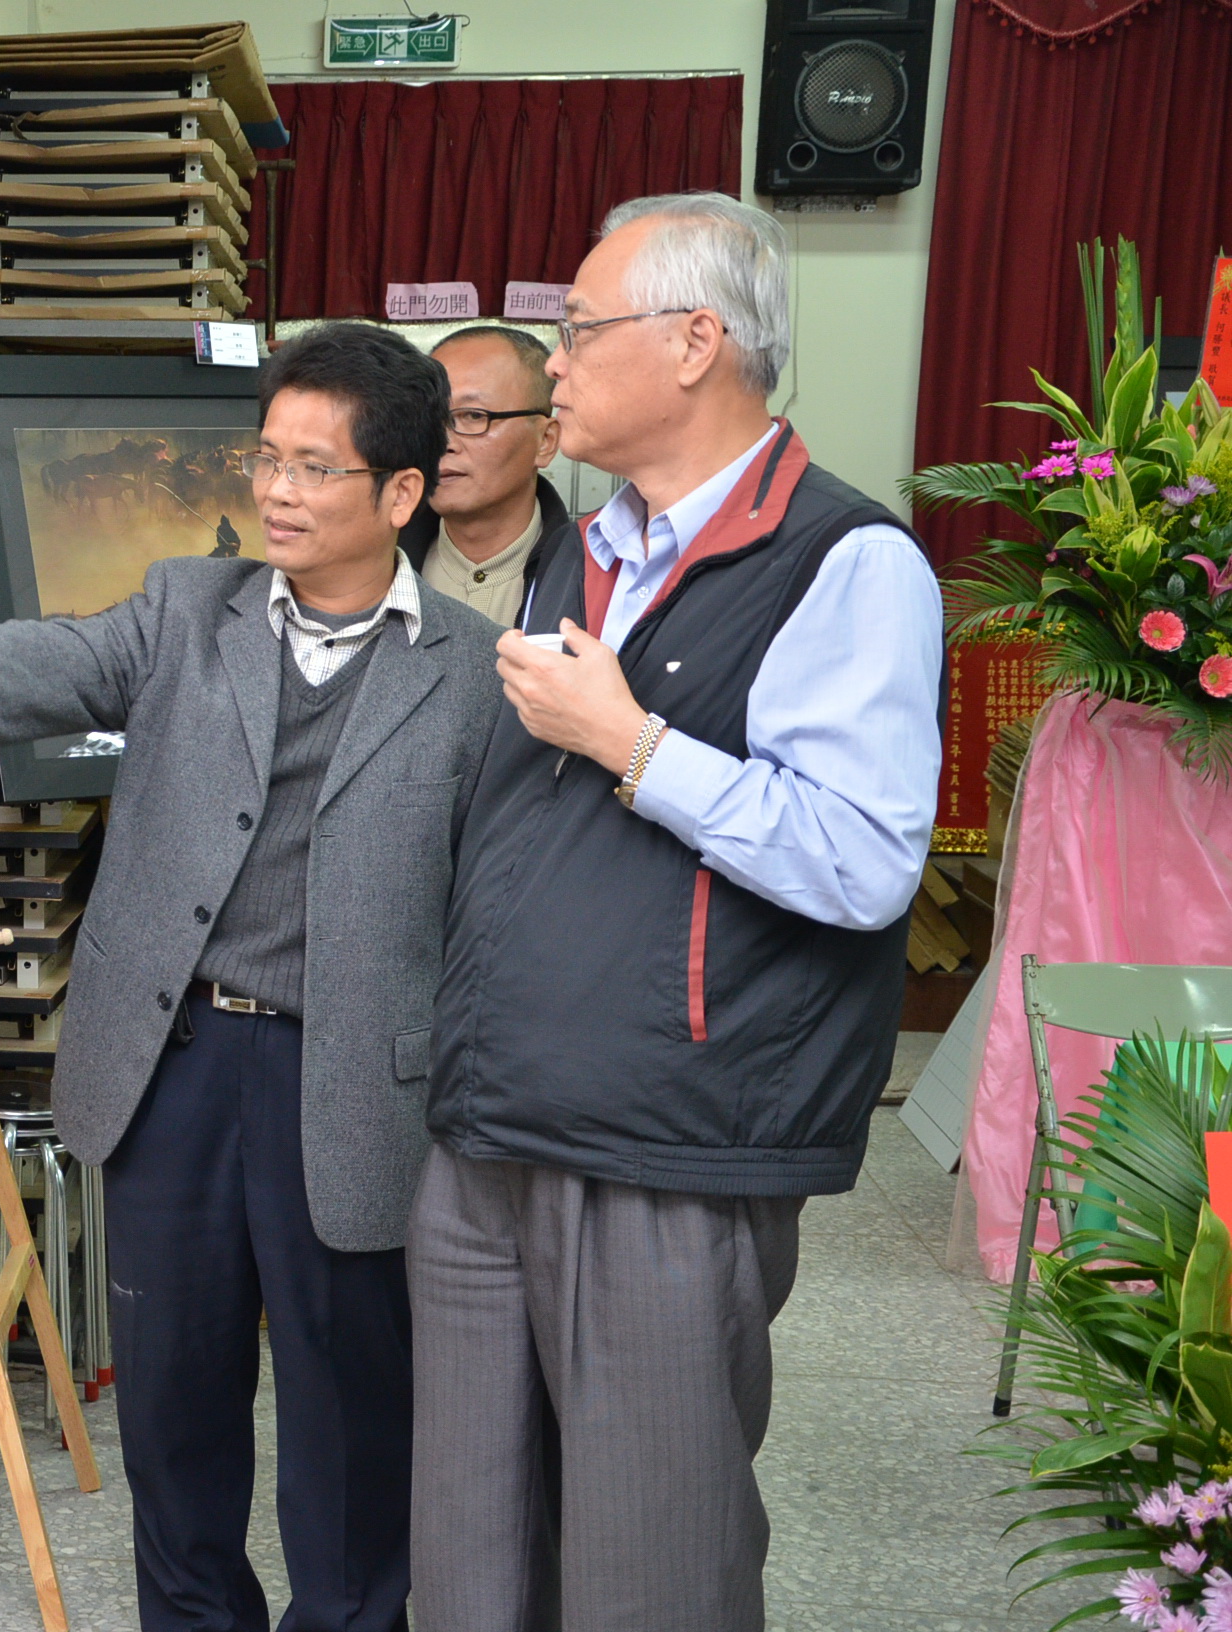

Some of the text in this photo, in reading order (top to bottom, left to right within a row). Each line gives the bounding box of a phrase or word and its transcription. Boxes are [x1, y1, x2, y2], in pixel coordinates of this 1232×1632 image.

[339, 34, 445, 49] 緊急 出口
[389, 293, 469, 316] 此門勿開
